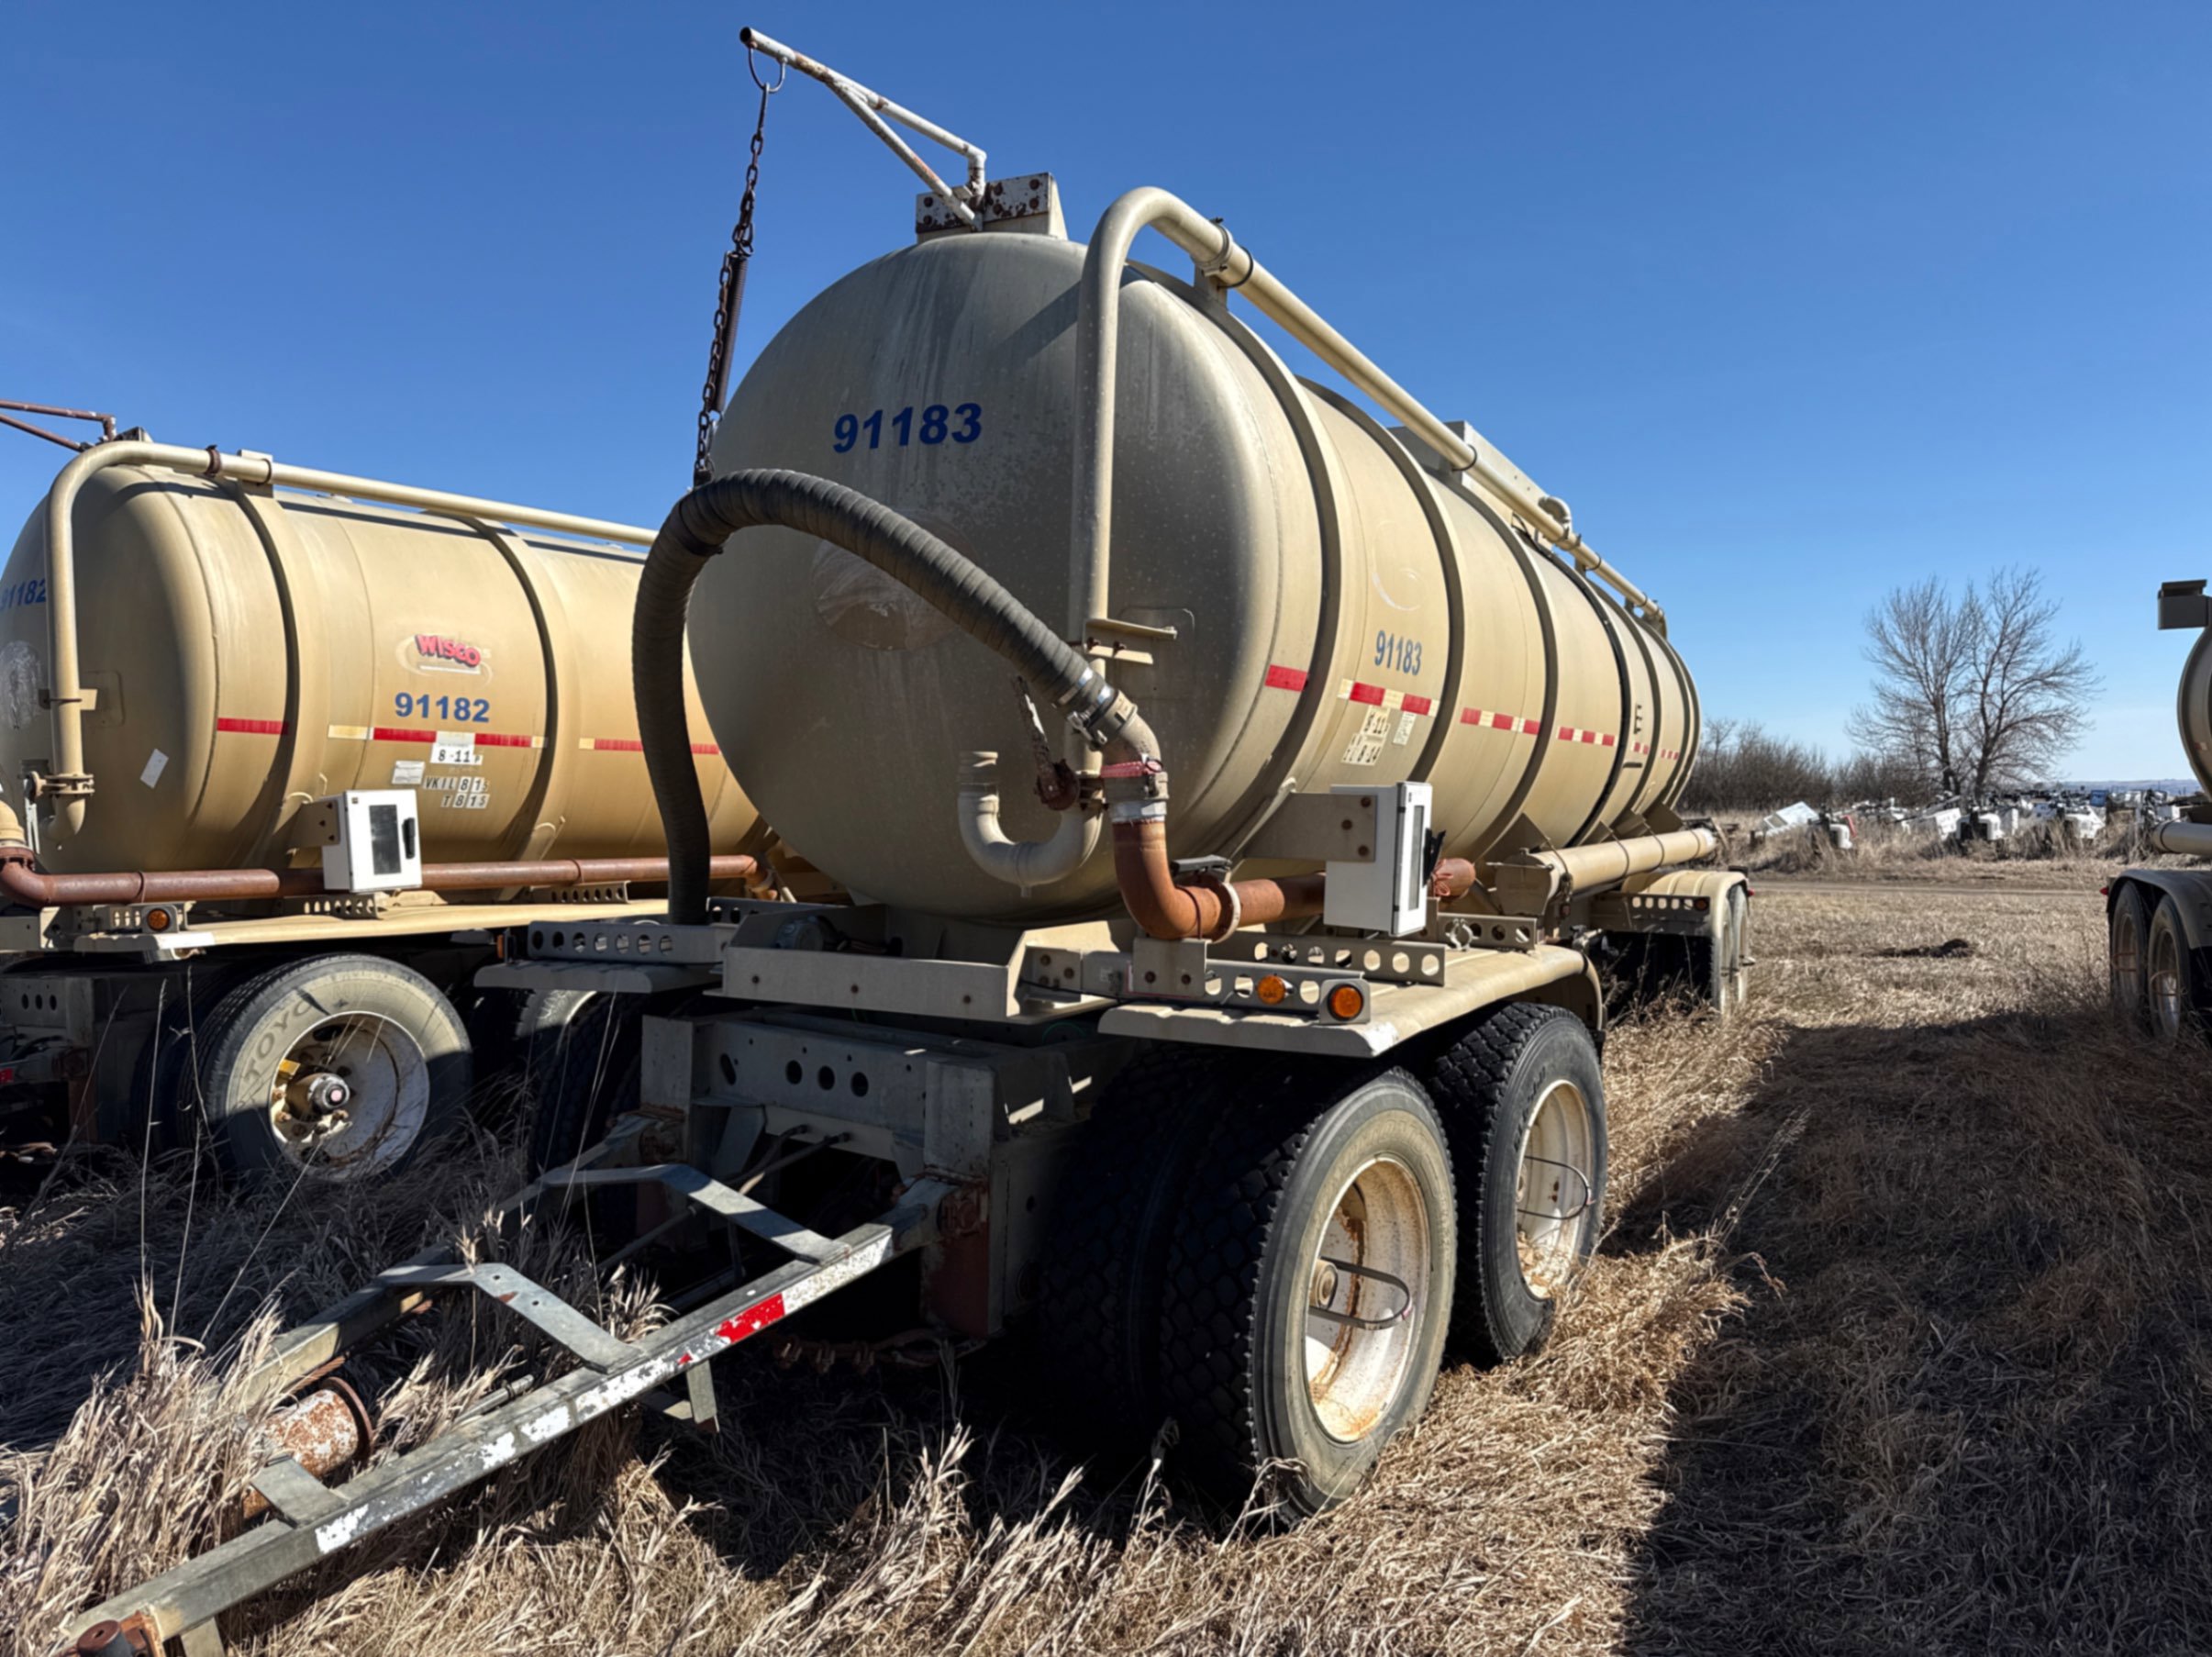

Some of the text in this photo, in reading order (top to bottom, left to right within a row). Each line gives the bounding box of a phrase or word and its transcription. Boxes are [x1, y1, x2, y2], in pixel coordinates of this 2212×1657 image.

[833, 402, 982, 453] 91183
[416, 633, 481, 667] WISCO
[1374, 629, 1422, 676] 91183
[395, 692, 490, 723] 91182
[240, 1000, 314, 1083] TOYO
